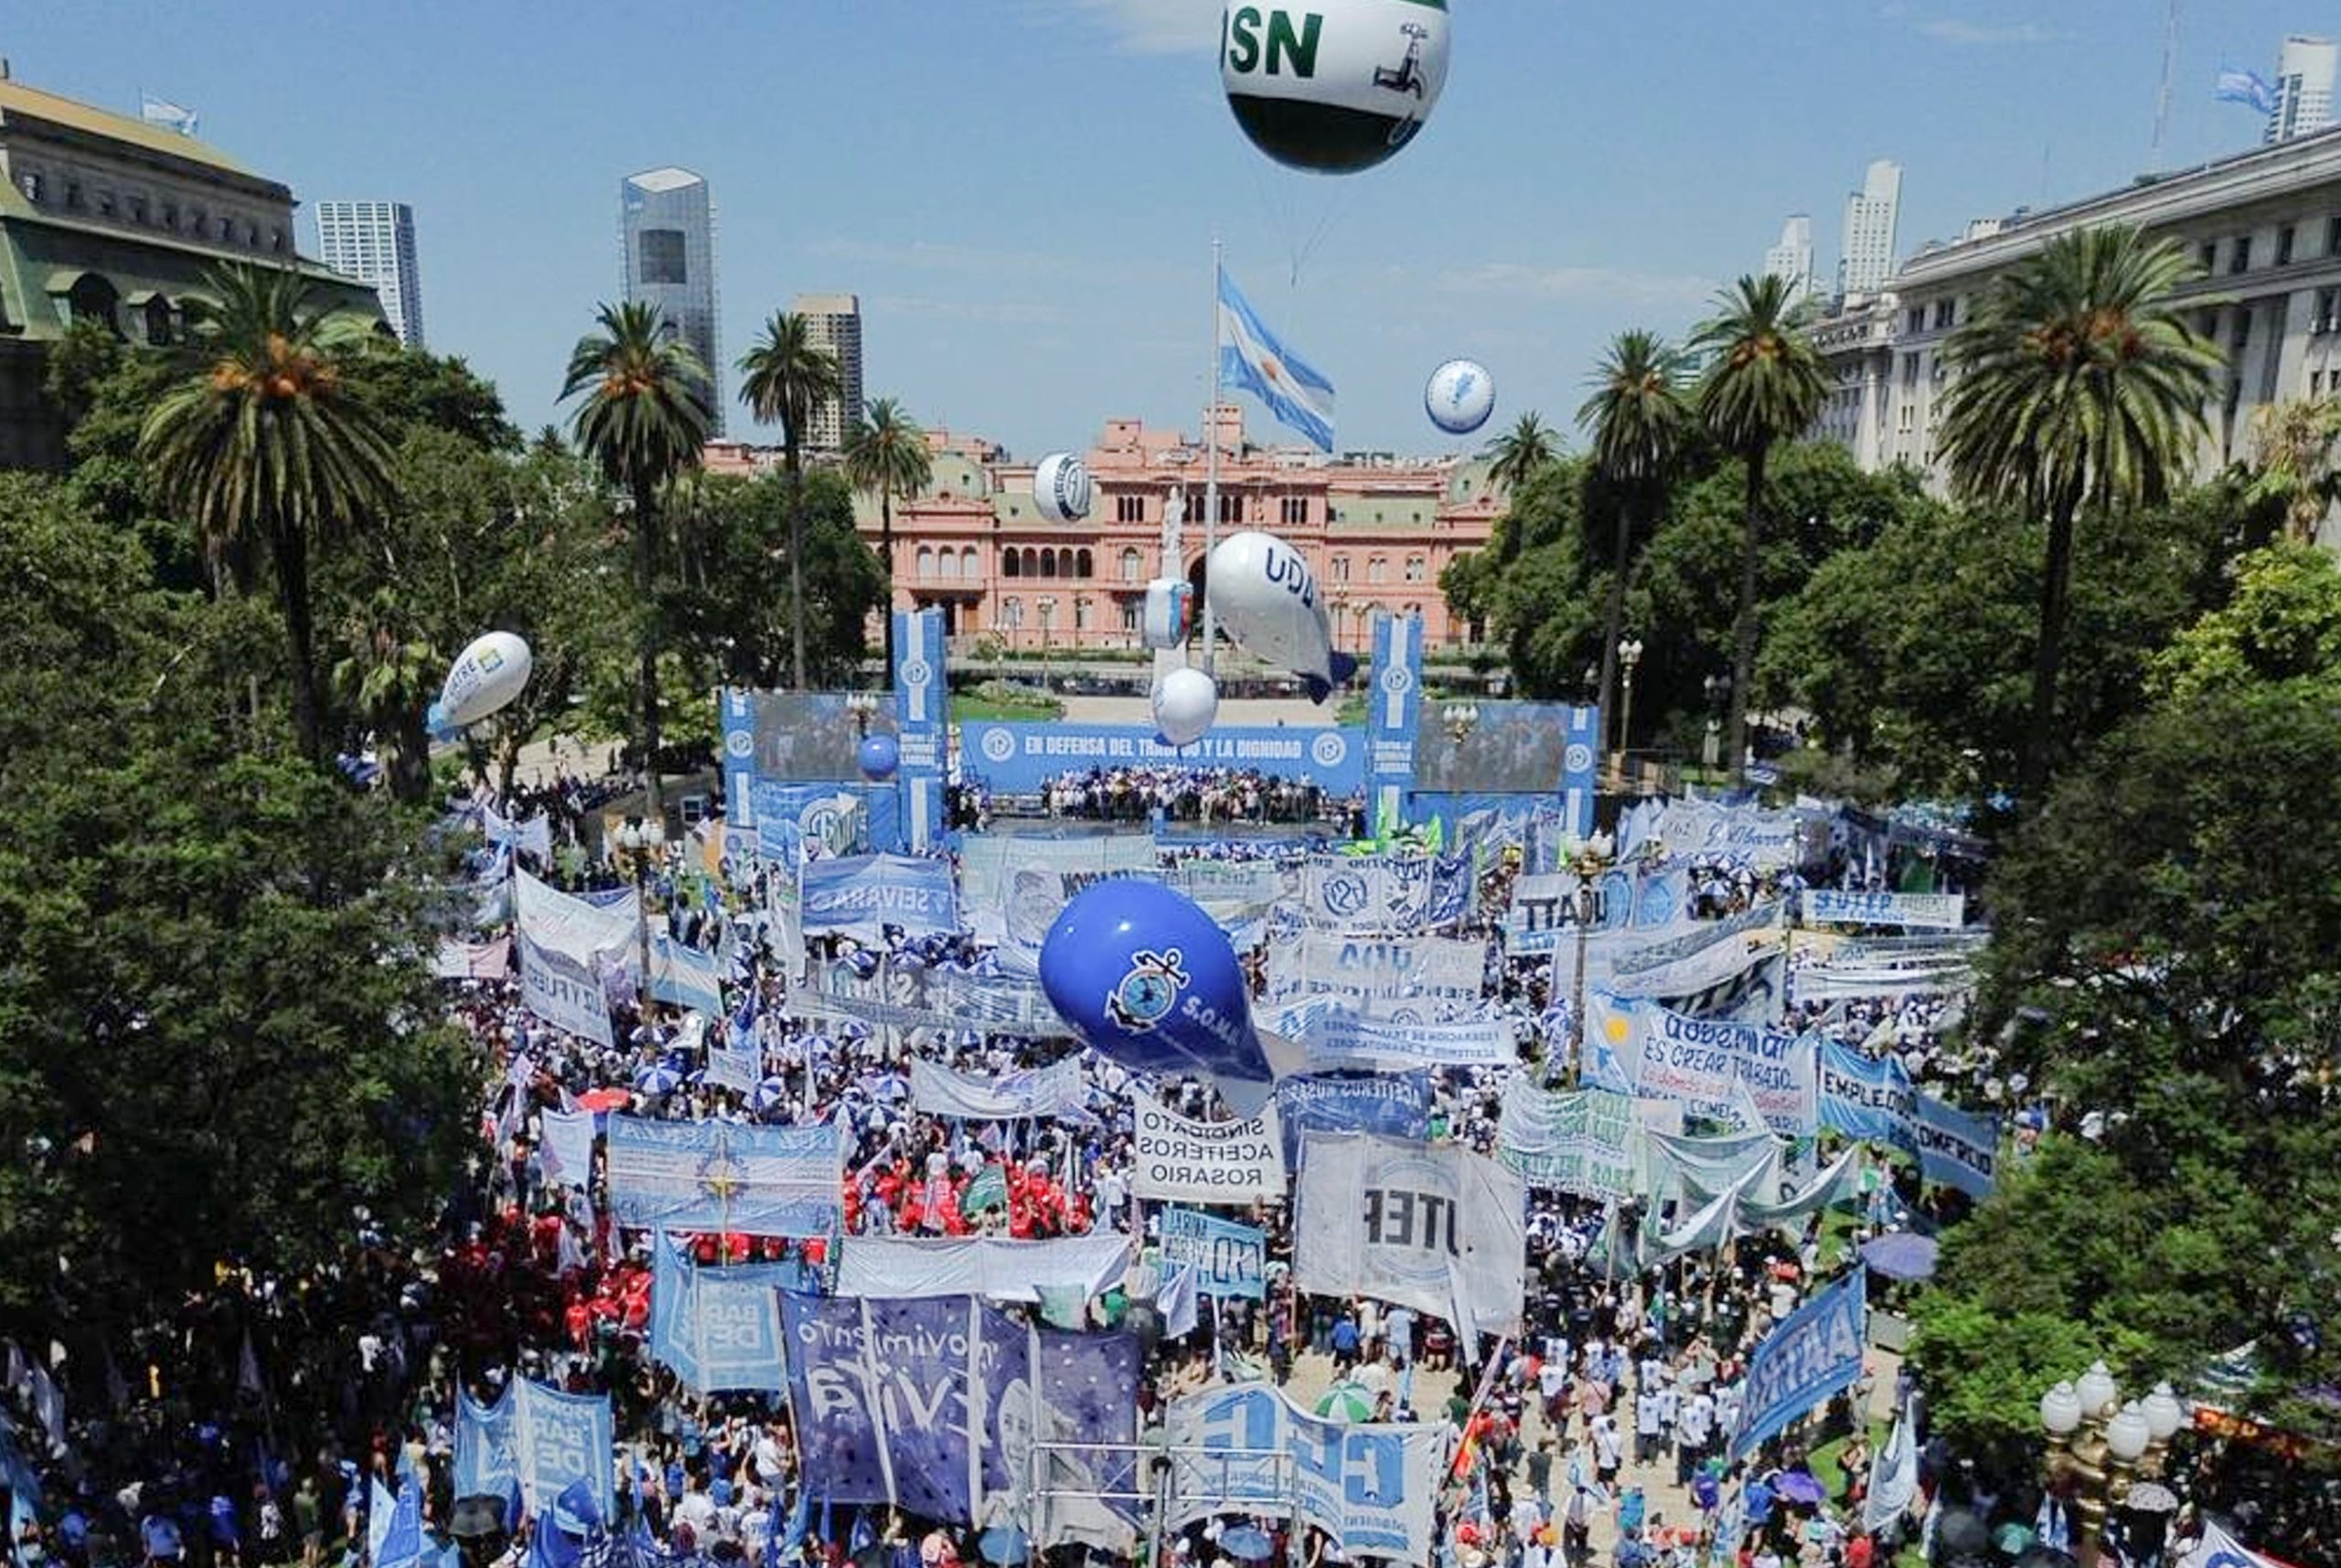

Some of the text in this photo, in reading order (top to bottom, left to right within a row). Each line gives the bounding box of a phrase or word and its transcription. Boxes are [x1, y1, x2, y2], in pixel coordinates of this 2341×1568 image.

[1220, 5, 1323, 79] SN
[1025, 736, 1043, 754] EN
[1046, 736, 1106, 755] DEFENSA
[1109, 737, 1134, 756] DEL
[1203, 738, 1213, 758] Y
[1215, 738, 1235, 758] LA
[1236, 739, 1302, 759] DIGNIDAD
[1644, 1036, 1665, 1062] ES
[1670, 1044, 1727, 1073] CREAR
